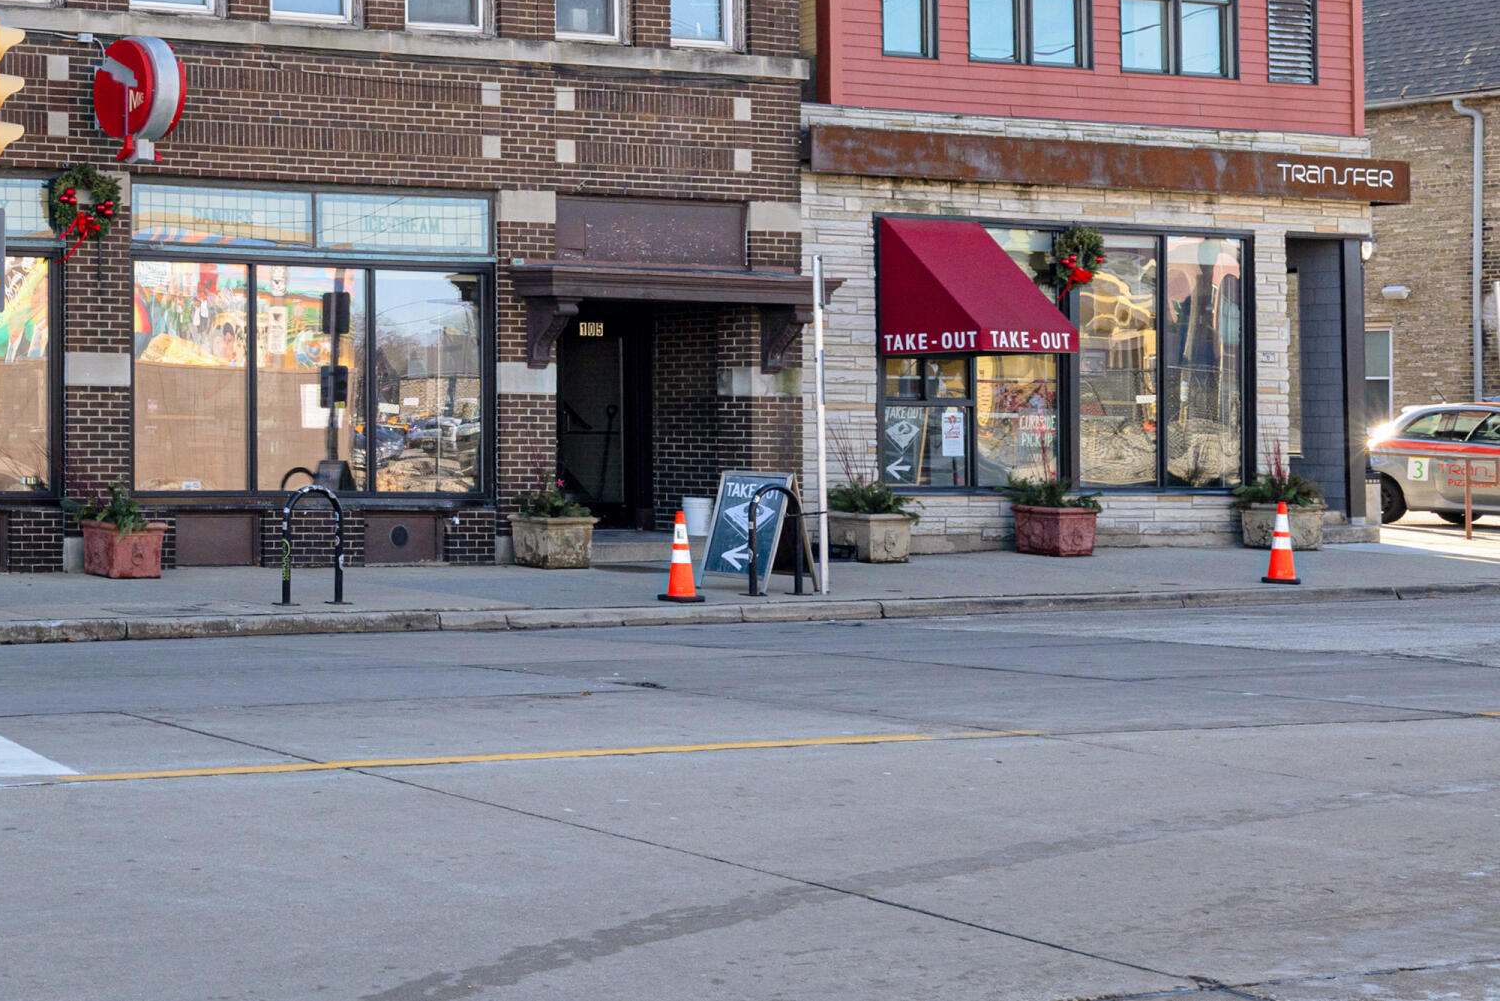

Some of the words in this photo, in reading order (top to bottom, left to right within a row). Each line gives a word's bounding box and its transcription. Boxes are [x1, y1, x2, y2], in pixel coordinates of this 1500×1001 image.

[192, 206, 254, 226] CANDIES
[579, 322, 604, 337] 105
[1412, 460, 1423, 479] 3
[726, 482, 756, 498] TAKE
